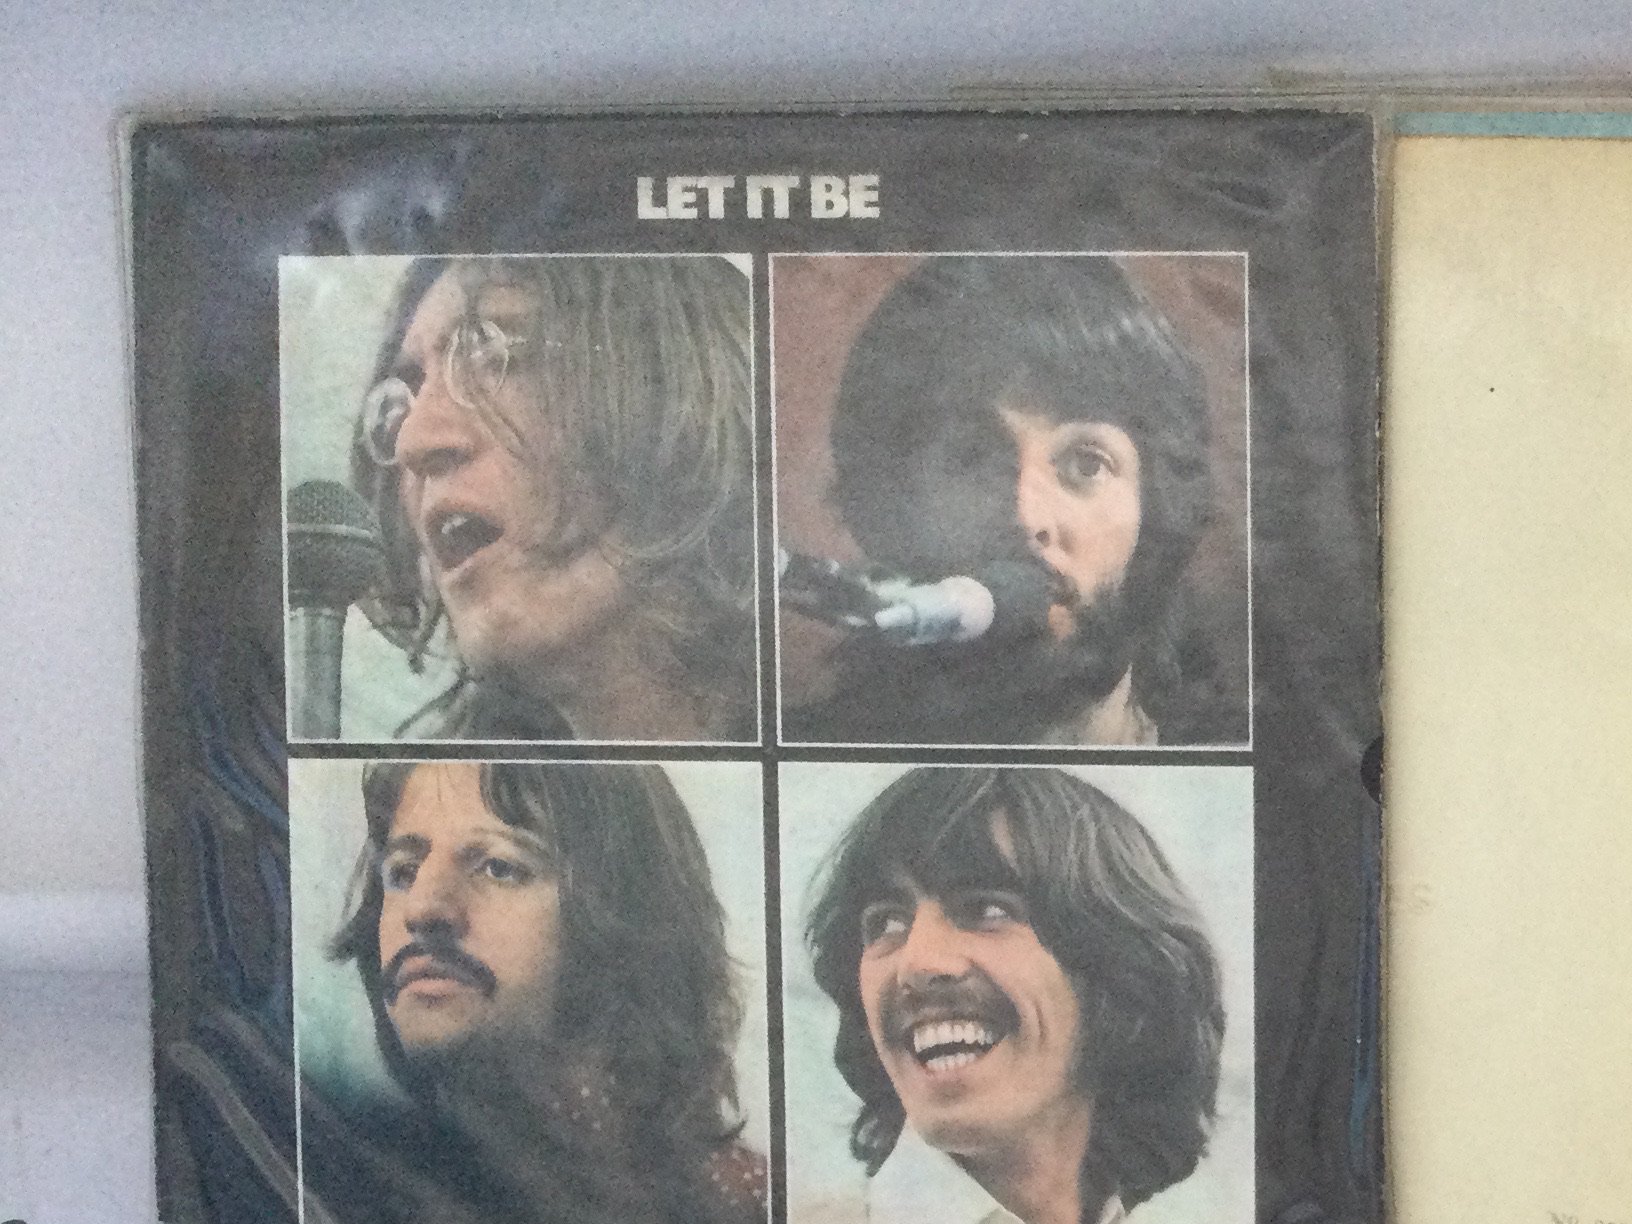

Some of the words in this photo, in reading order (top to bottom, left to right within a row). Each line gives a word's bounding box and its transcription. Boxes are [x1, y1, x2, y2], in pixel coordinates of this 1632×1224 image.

[637, 175, 736, 219] LET
[746, 175, 800, 219] IT
[810, 174, 880, 218] BE
